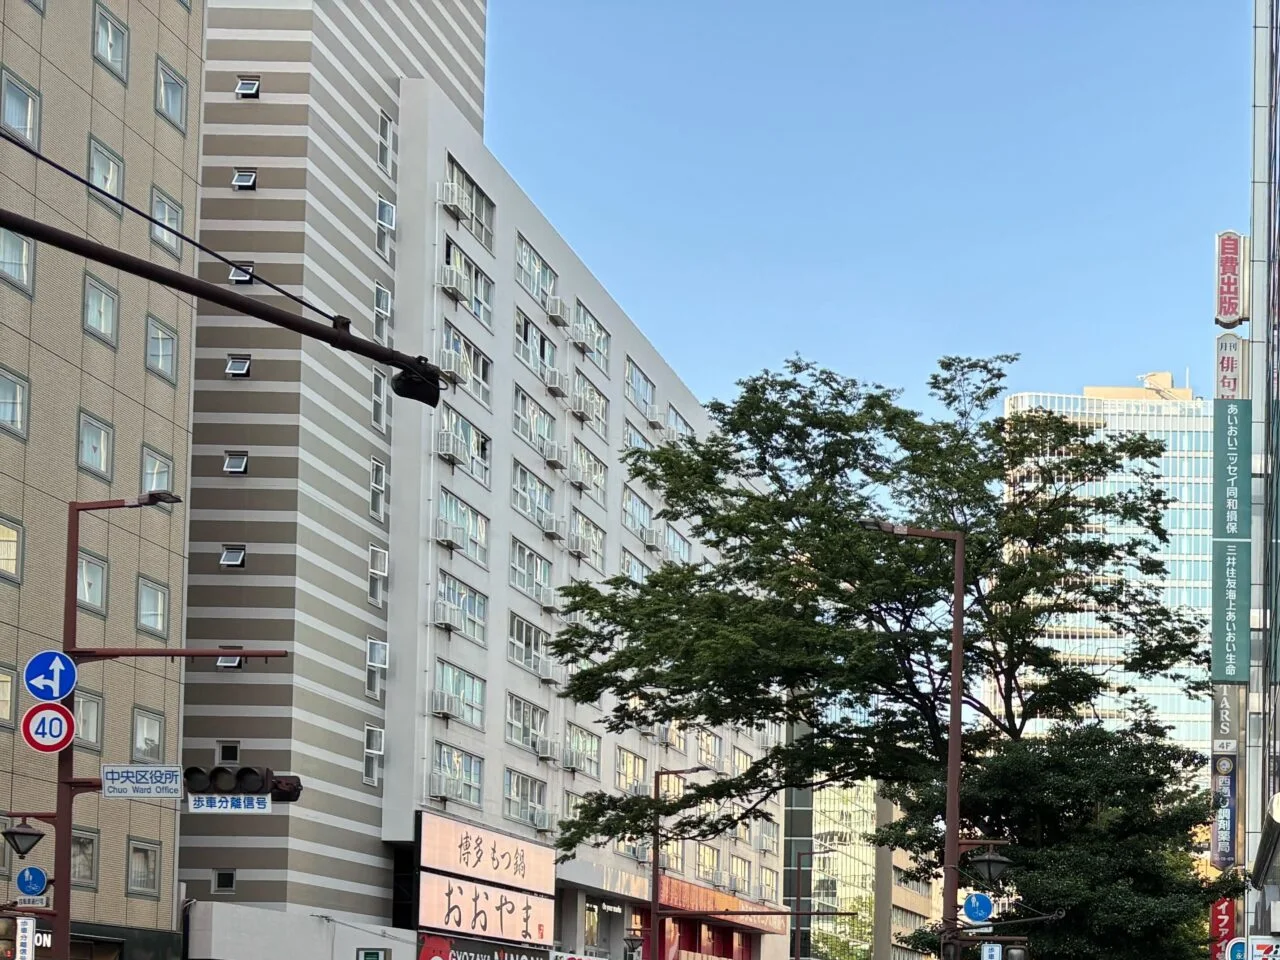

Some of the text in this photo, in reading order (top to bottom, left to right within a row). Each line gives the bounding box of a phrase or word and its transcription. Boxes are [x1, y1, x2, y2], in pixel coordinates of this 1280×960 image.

[1218, 235, 1240, 316] 自費出版
[1219, 341, 1238, 352] 月刊
[1219, 355, 1238, 399] 俳句
[1226, 403, 1239, 534] あいおいニッセイ同和損保
[1225, 545, 1237, 676] 三井住友海上あいおい生命
[34, 717, 63, 739] 40
[1218, 742, 1231, 750] 4F
[105, 769, 179, 785] 中央区役所
[107, 785, 179, 794] Chuo Ward Office
[193, 796, 268, 810] 歩車分離信号
[444, 879, 532, 939] おおやま
